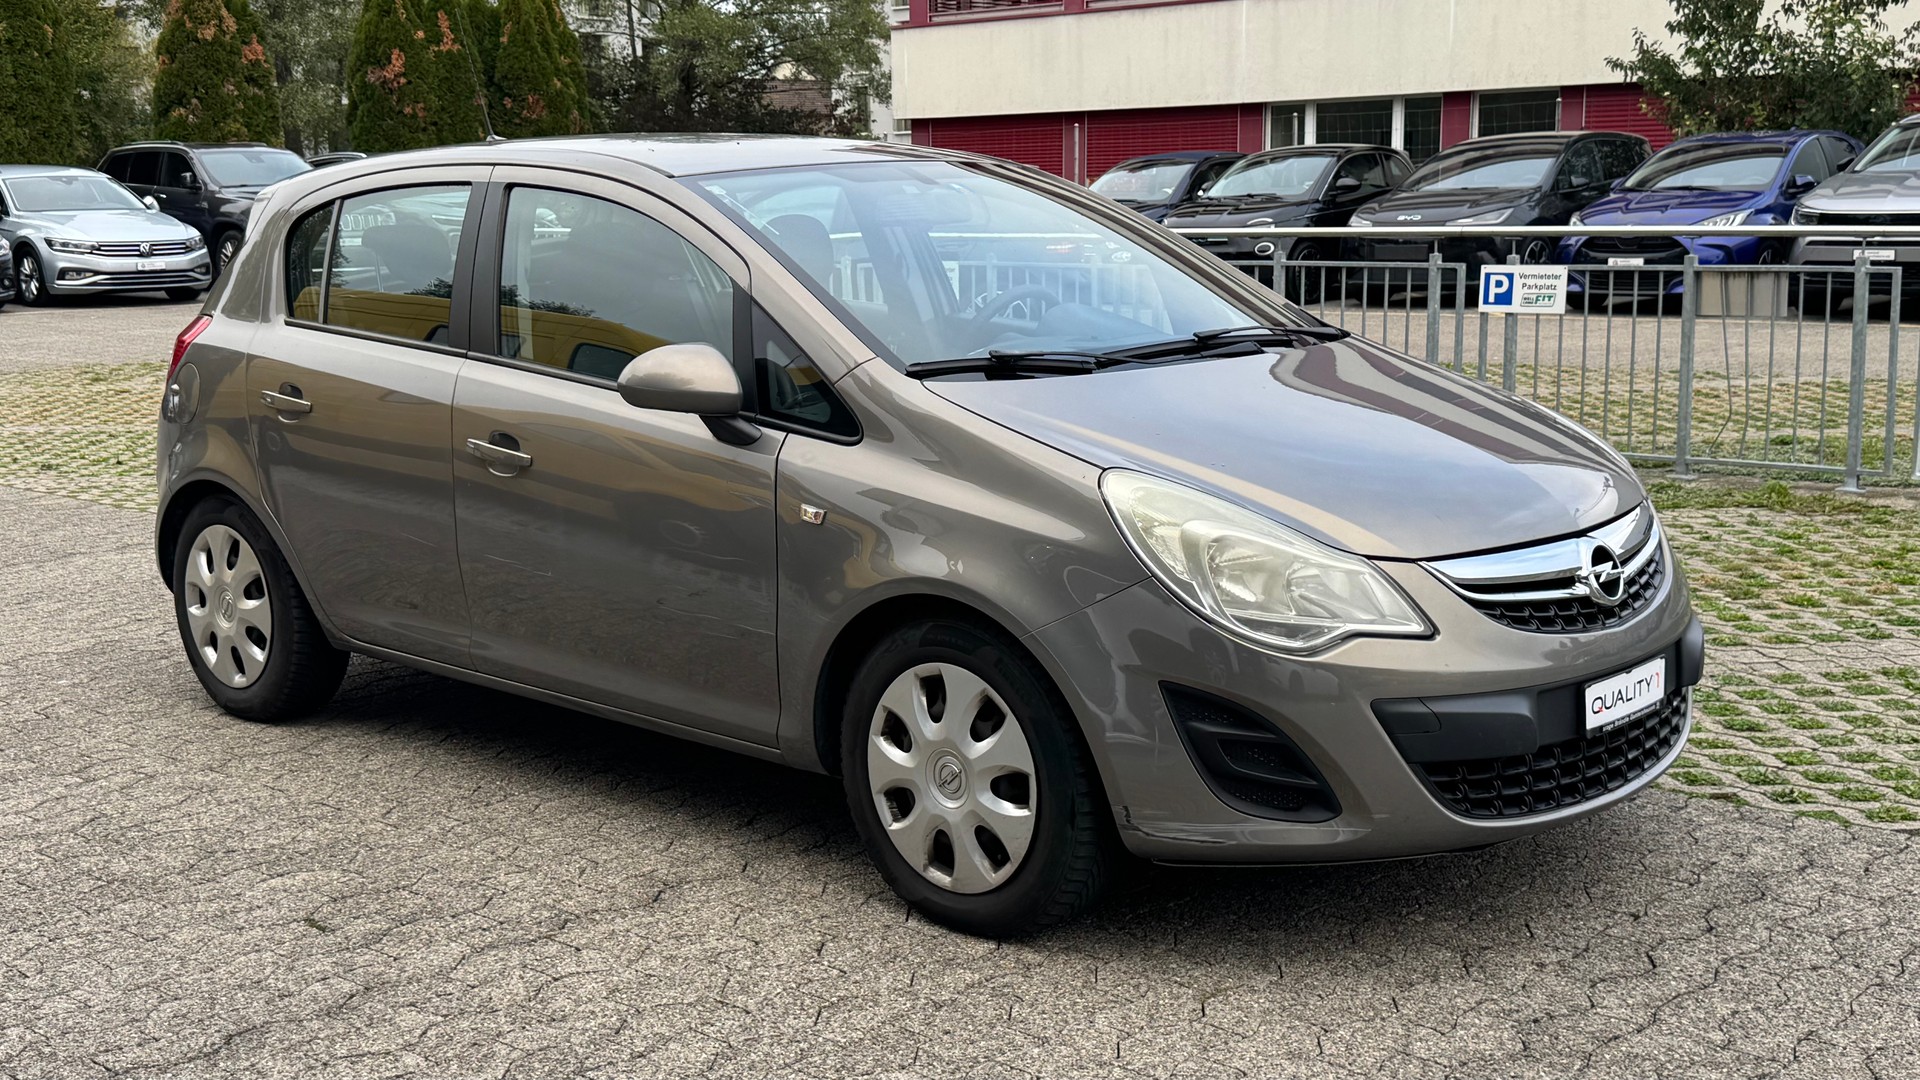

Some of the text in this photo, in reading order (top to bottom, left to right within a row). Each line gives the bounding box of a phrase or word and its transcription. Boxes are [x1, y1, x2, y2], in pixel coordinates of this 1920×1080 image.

[1519, 272, 1562, 280] Vermieteter
[1488, 274, 1510, 303] P
[1522, 282, 1557, 292] Parkplatz
[1534, 295, 1554, 305] FIT
